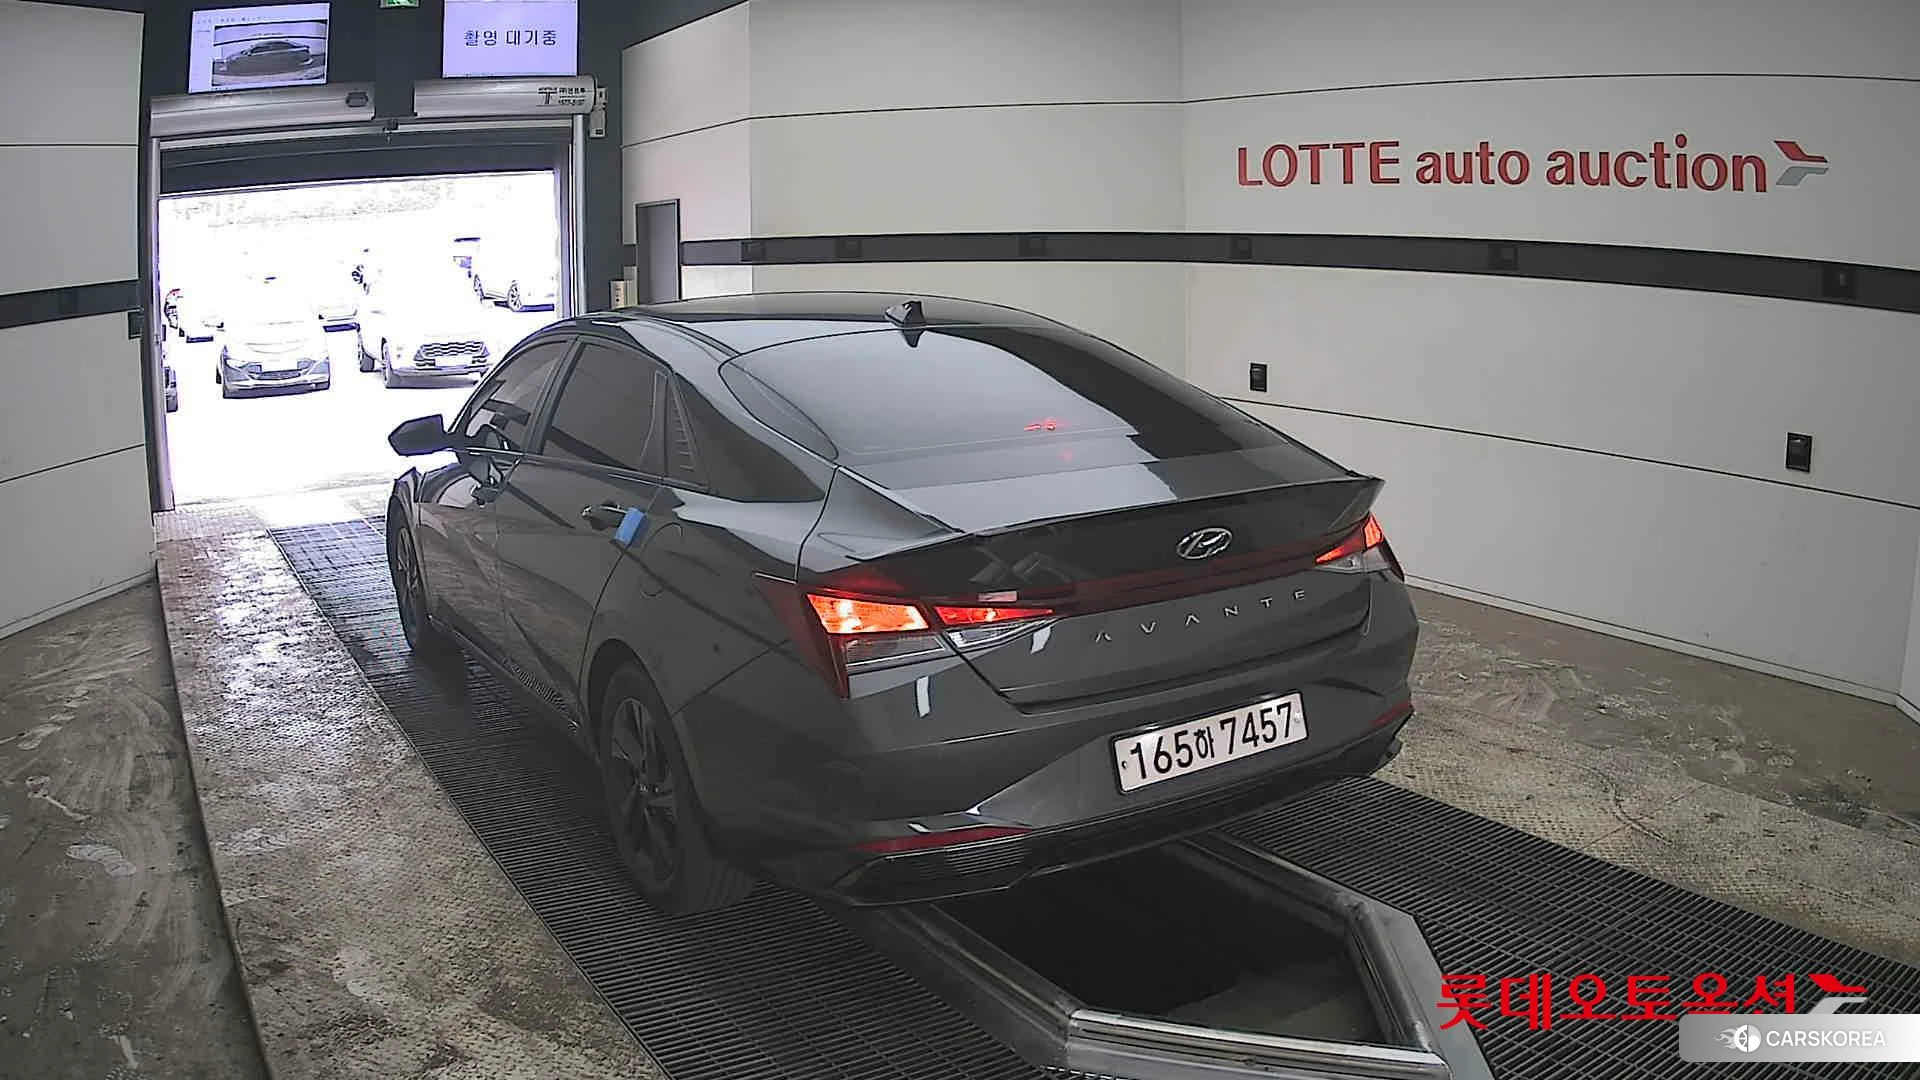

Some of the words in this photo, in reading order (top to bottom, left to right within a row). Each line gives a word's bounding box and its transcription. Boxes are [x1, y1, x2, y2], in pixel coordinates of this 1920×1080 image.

[505, 29, 556, 46] 대기중
[1237, 140, 1400, 187] LOTTE
[1415, 141, 1531, 185] auto
[1545, 133, 1767, 193] auction
[1095, 589, 1305, 643] AVANTE
